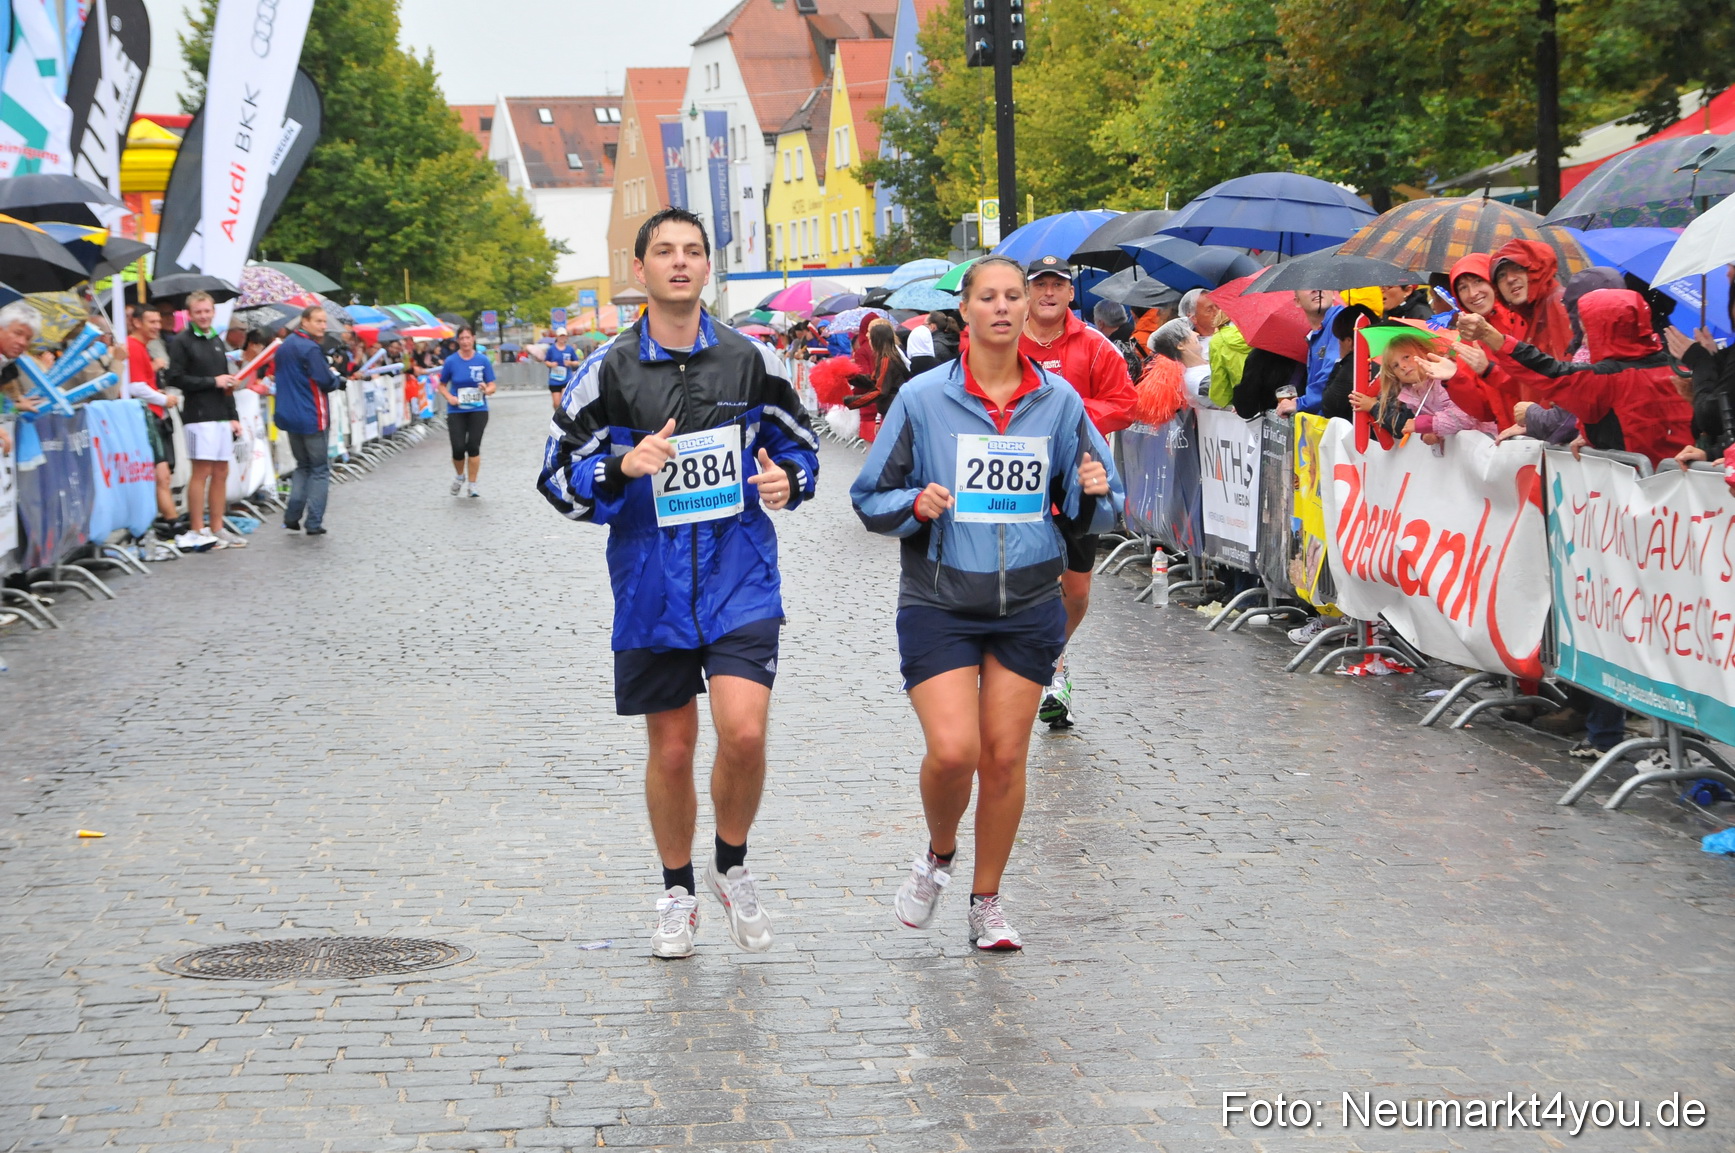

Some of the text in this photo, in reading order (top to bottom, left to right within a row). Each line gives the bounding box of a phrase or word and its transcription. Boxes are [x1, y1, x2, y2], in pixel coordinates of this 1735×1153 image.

[220, 82, 261, 243] Audi BKK
[717, 162, 728, 212] RUPPERT
[677, 435, 715, 451] BOCK
[987, 441, 1026, 451] BOCK
[661, 450, 737, 493] 2884
[966, 458, 1042, 492] 2883
[668, 491, 738, 513] Christopher
[987, 497, 1017, 511] Julia
